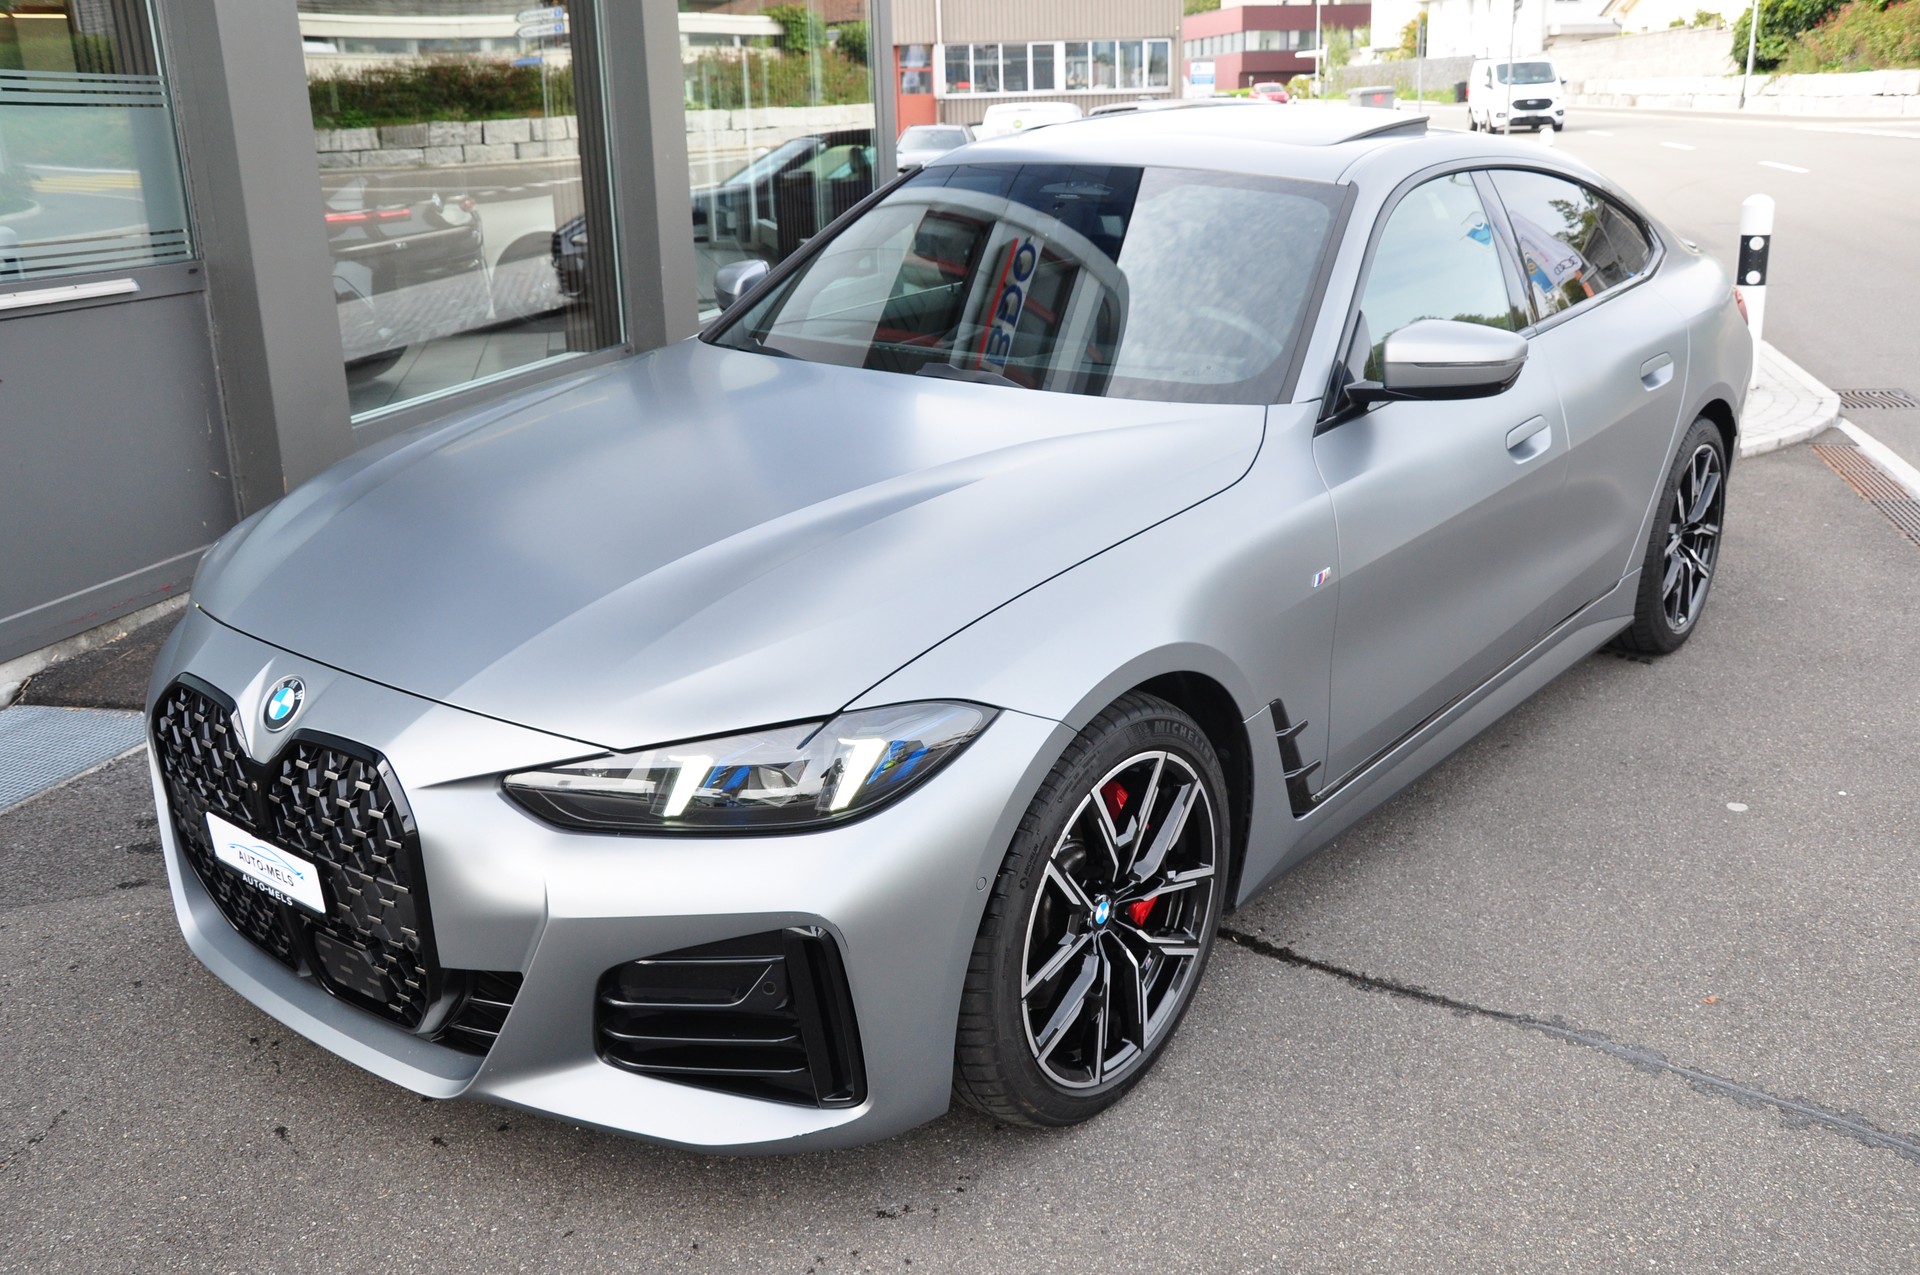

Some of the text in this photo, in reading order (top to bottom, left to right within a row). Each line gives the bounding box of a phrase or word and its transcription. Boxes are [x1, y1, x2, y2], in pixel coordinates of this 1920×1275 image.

[986, 242, 1036, 367] BDO
[1154, 720, 1210, 759] MICHELIN
[238, 850, 295, 886] AUTO-MELS
[242, 873, 293, 906] AUTO-MELS
